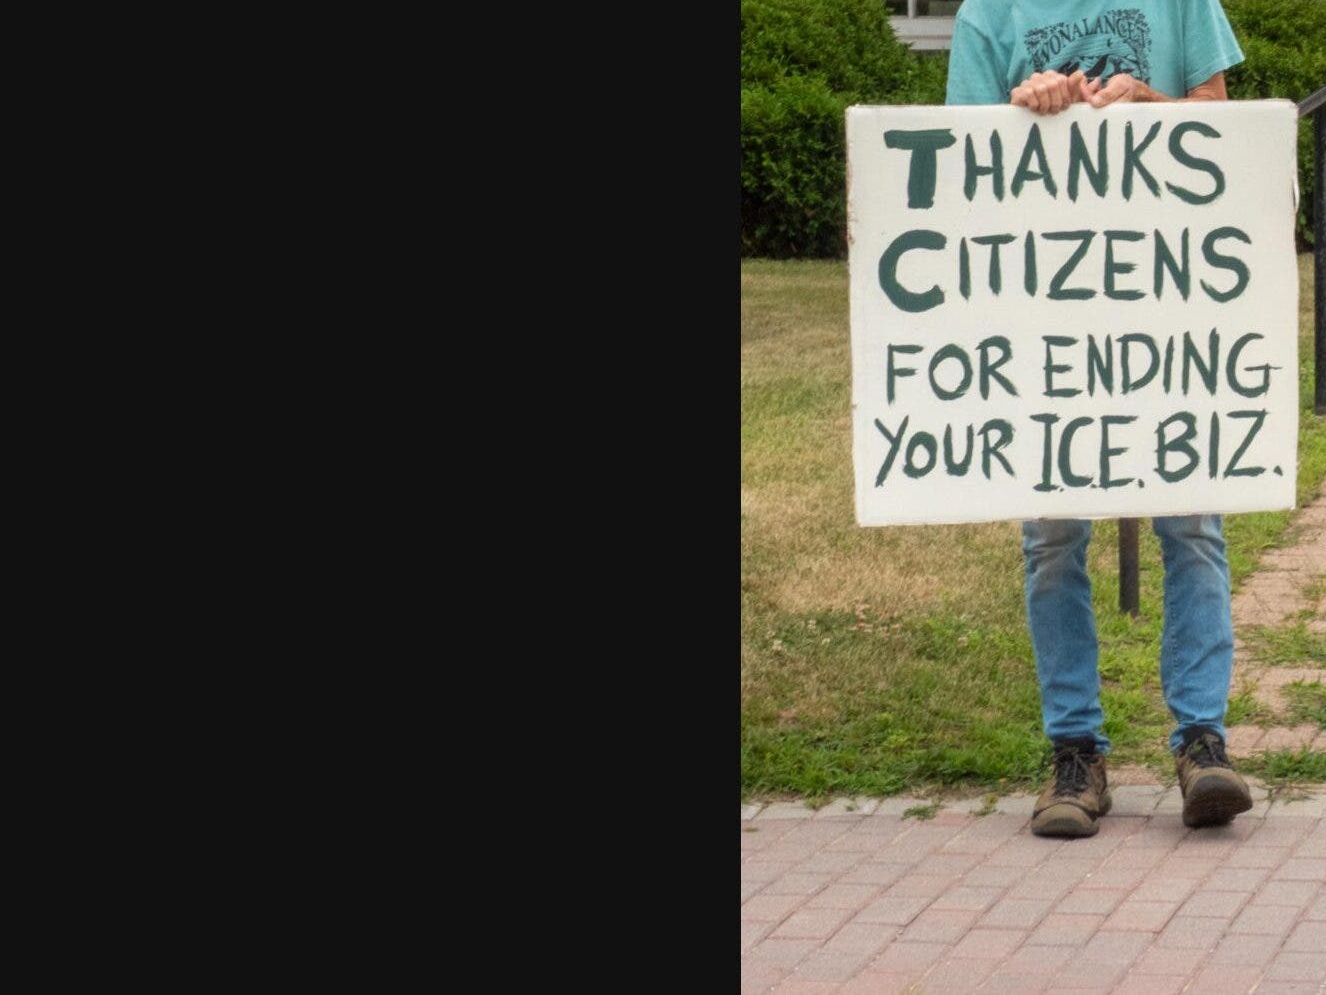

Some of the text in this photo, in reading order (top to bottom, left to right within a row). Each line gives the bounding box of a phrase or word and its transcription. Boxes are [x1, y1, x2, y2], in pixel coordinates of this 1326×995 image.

[884, 120, 1225, 209] THANKS
[879, 227, 1252, 313] CITIZENS
[887, 328, 1282, 405] FOR ENDING
[875, 415, 1016, 488] YOUR
[1154, 409, 1283, 483] BIZ.
